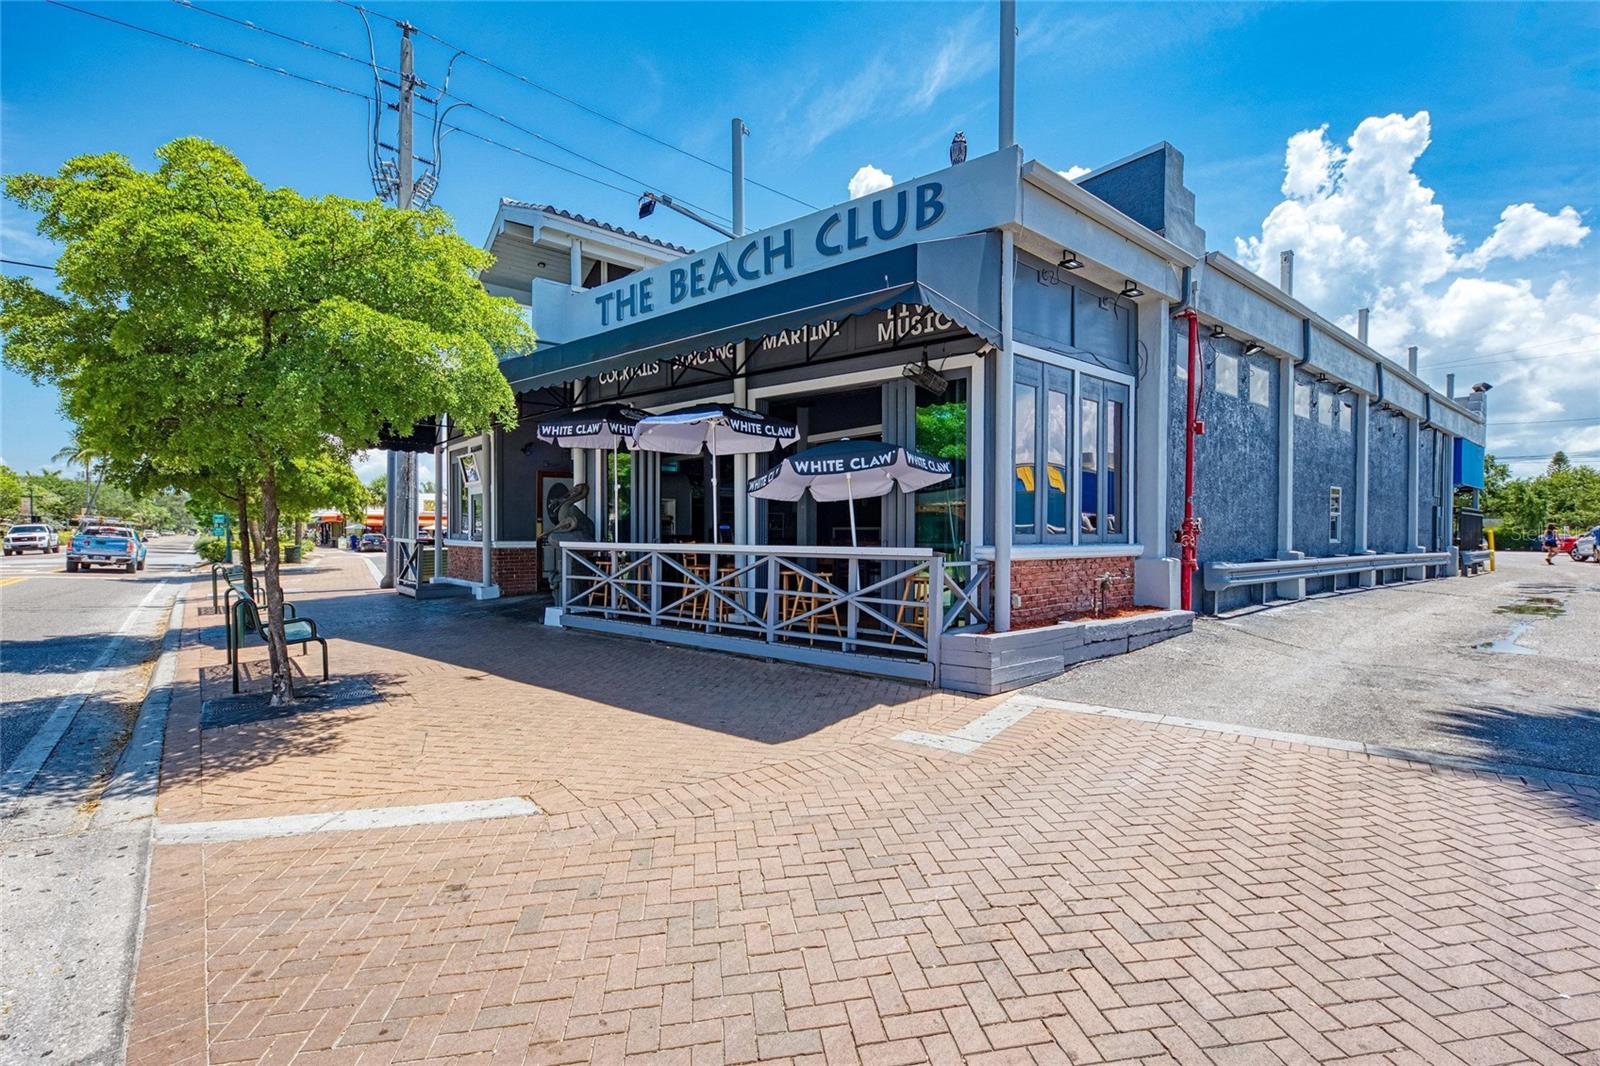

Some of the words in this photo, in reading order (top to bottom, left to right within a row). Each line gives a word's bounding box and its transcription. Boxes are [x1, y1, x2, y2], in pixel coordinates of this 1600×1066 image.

[595, 277, 654, 326] THE
[670, 229, 794, 305] BEACH
[816, 182, 945, 257] CLUB
[877, 312, 953, 342] MUSIC
[541, 425, 573, 436] WHITE
[576, 423, 600, 435] CLAW
[609, 422, 635, 435] WHIT
[730, 418, 762, 435] WHITE
[765, 424, 793, 437] CLAW
[794, 459, 845, 473] WHITE
[850, 451, 894, 470] CLAW
[906, 451, 928, 470] WHITE
[928, 460, 950, 473] CLAW
